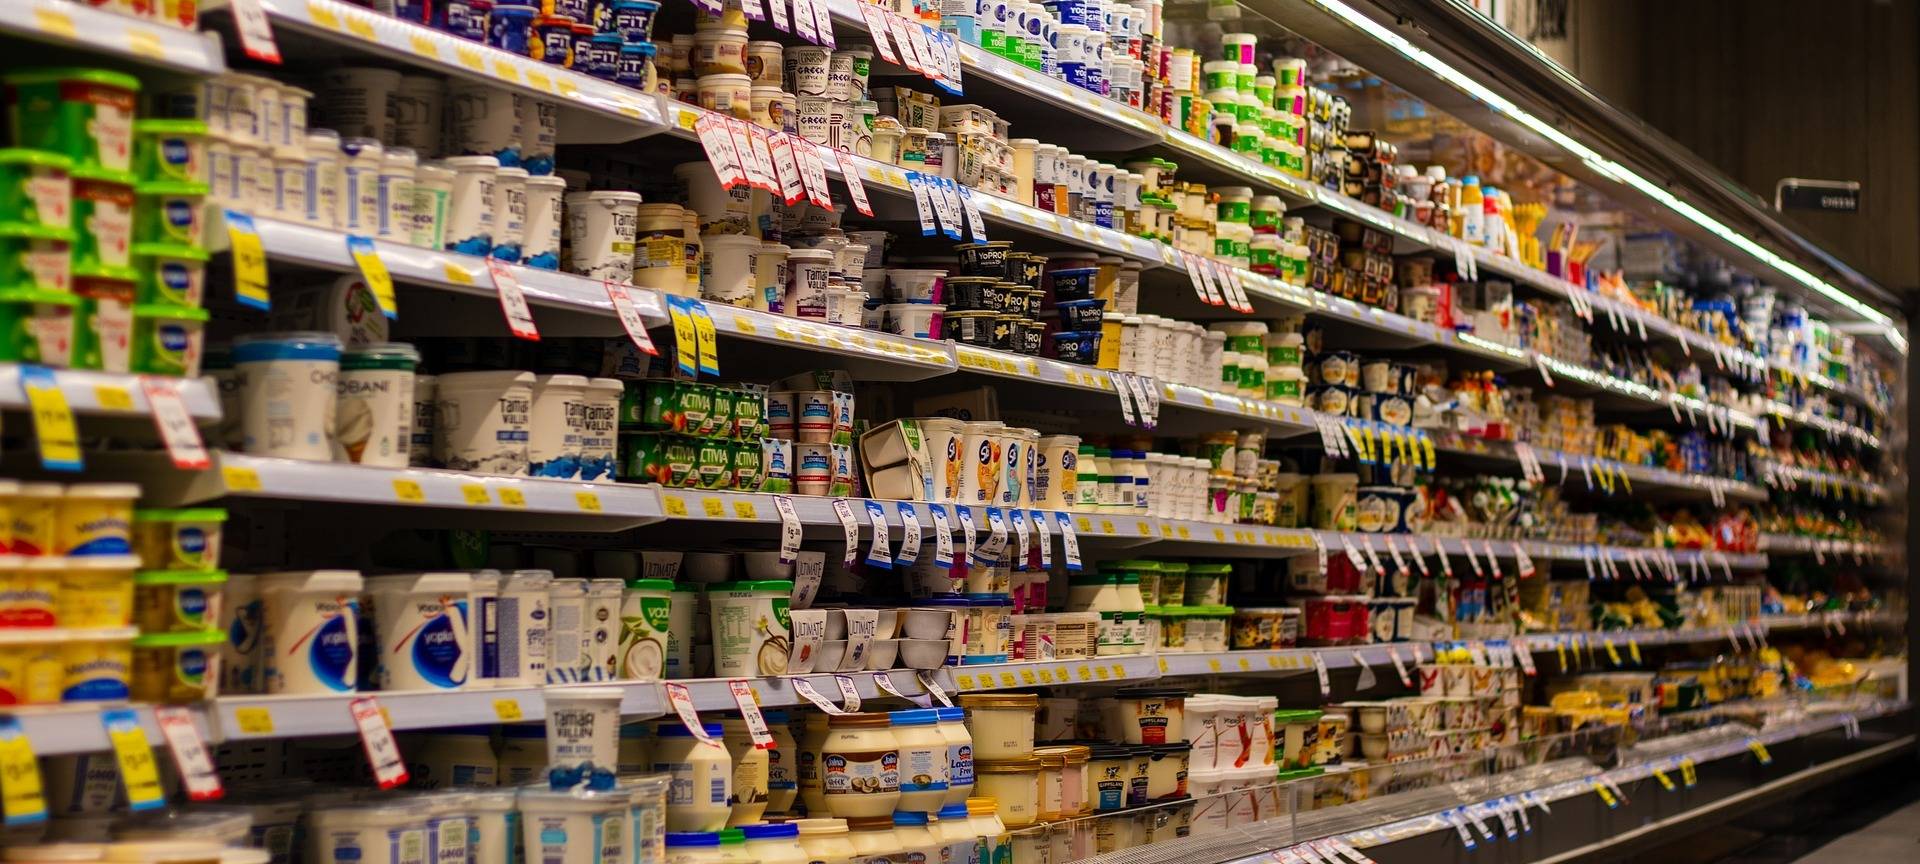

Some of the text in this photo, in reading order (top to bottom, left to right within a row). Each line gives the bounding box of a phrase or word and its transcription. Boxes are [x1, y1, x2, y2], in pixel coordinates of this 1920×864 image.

[679, 393, 711, 411] ACTIVIA
[735, 401, 760, 418] ACTIVIA
[700, 447, 728, 464] CTIVIA
[735, 452, 760, 467] ACTIVIA
[794, 620, 824, 638] ULTIMATE
[848, 620, 876, 637] ULTIMATE
